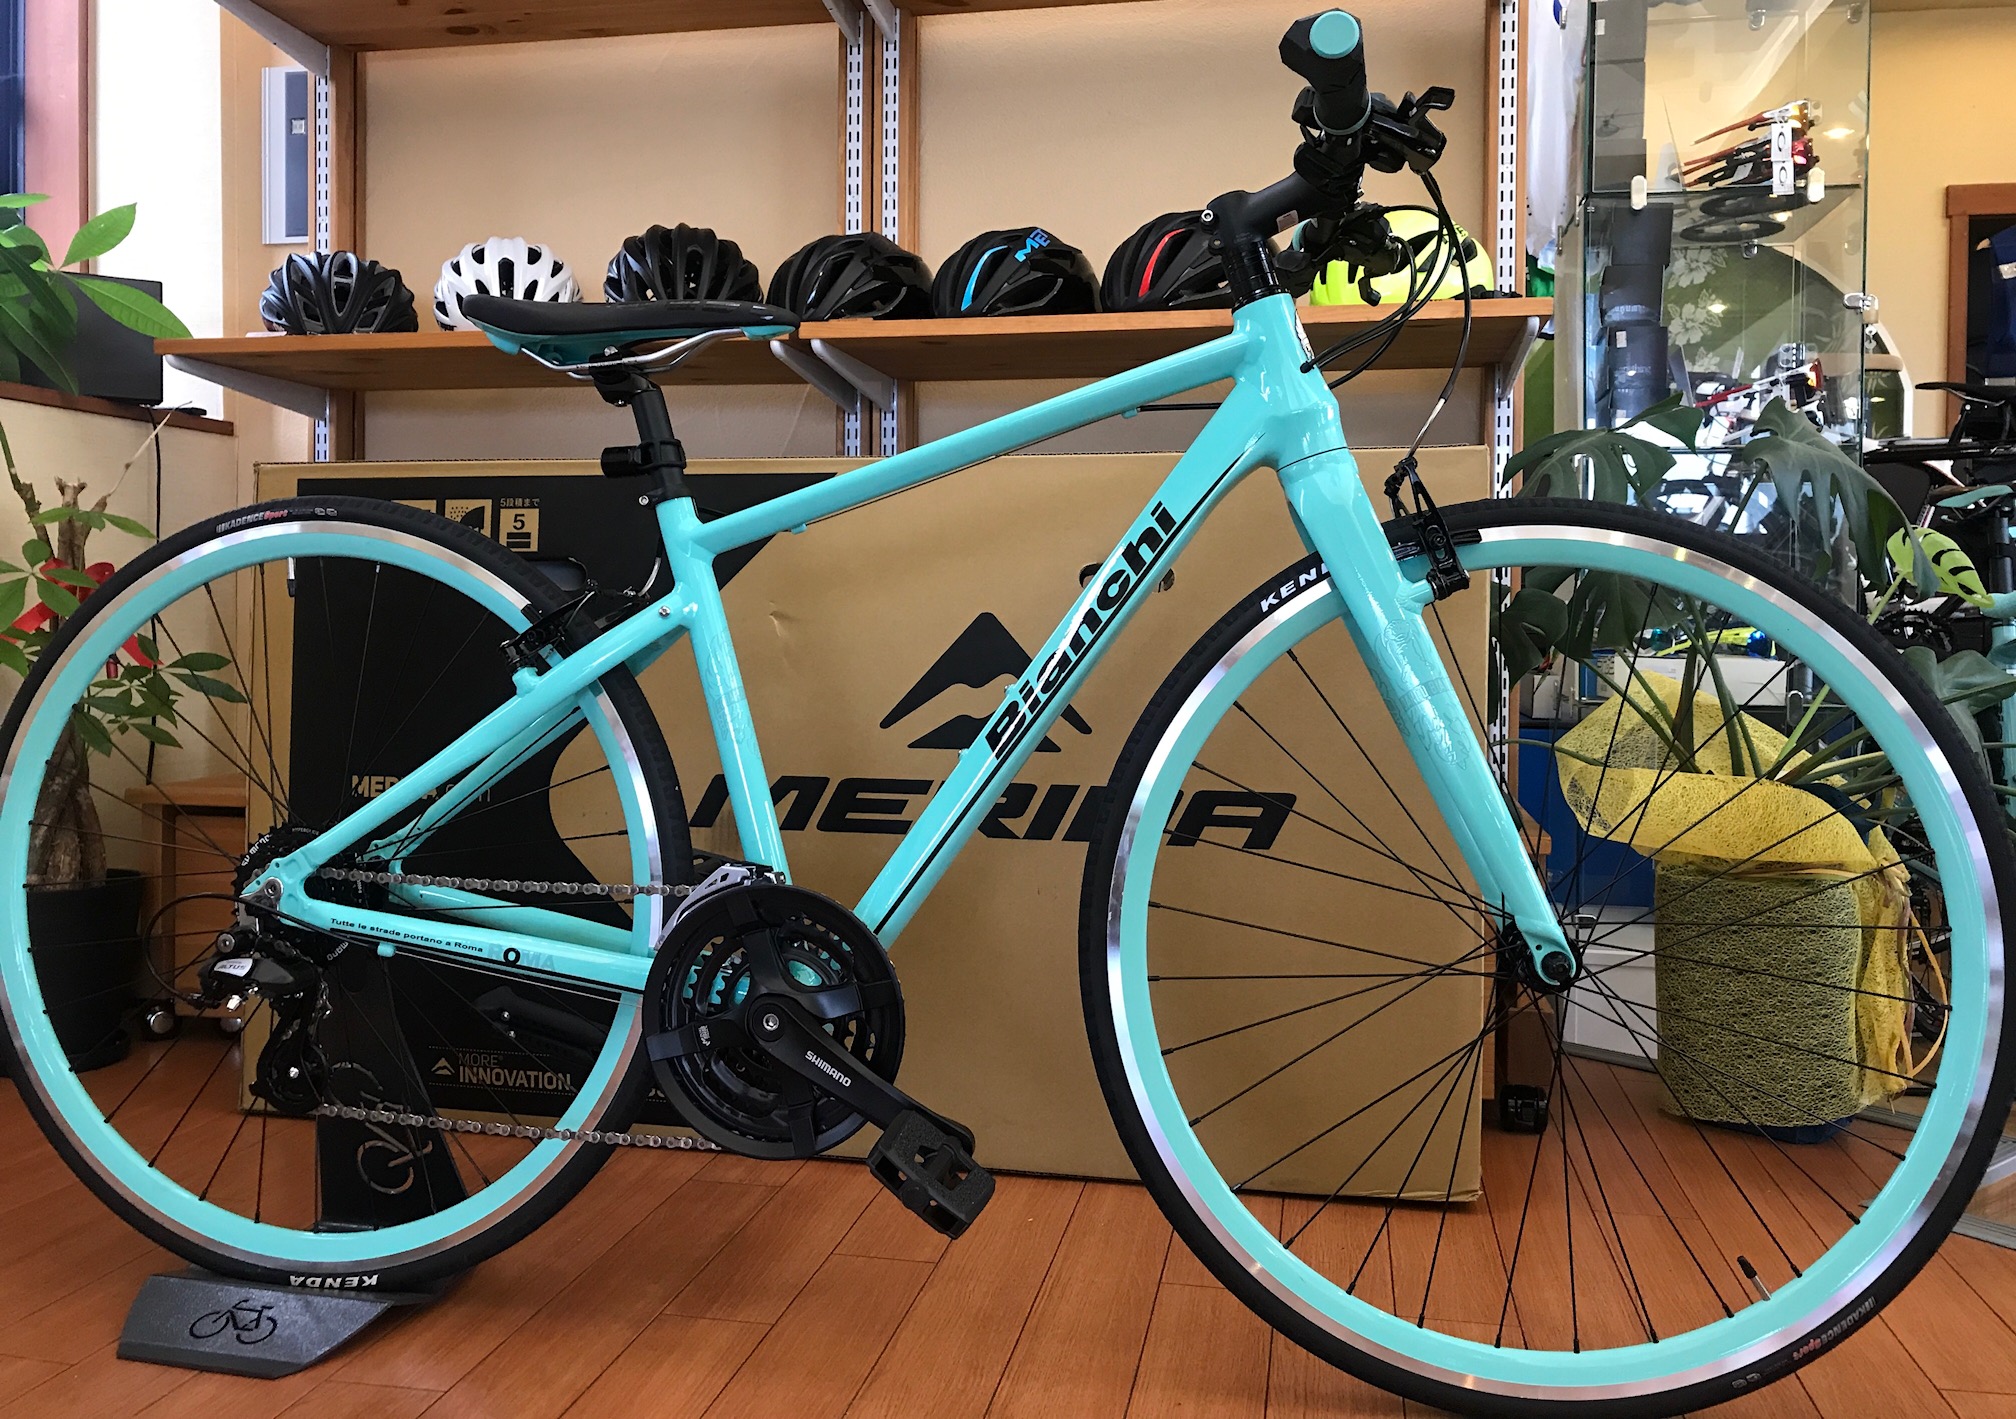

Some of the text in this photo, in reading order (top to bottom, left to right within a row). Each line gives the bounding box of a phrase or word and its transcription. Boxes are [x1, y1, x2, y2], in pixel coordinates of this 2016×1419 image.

[225, 511, 264, 531] KADENCE
[512, 513, 526, 531] 5
[985, 500, 1177, 761] Bianchi
[330, 917, 355, 928] Tutte
[370, 926, 401, 936] strade
[403, 933, 442, 945] portano
[454, 941, 483, 953] Roma
[459, 1065, 572, 1091] INNOVATION
[804, 1049, 852, 1088] SHIMANO
[289, 1273, 379, 1289] KENDA
